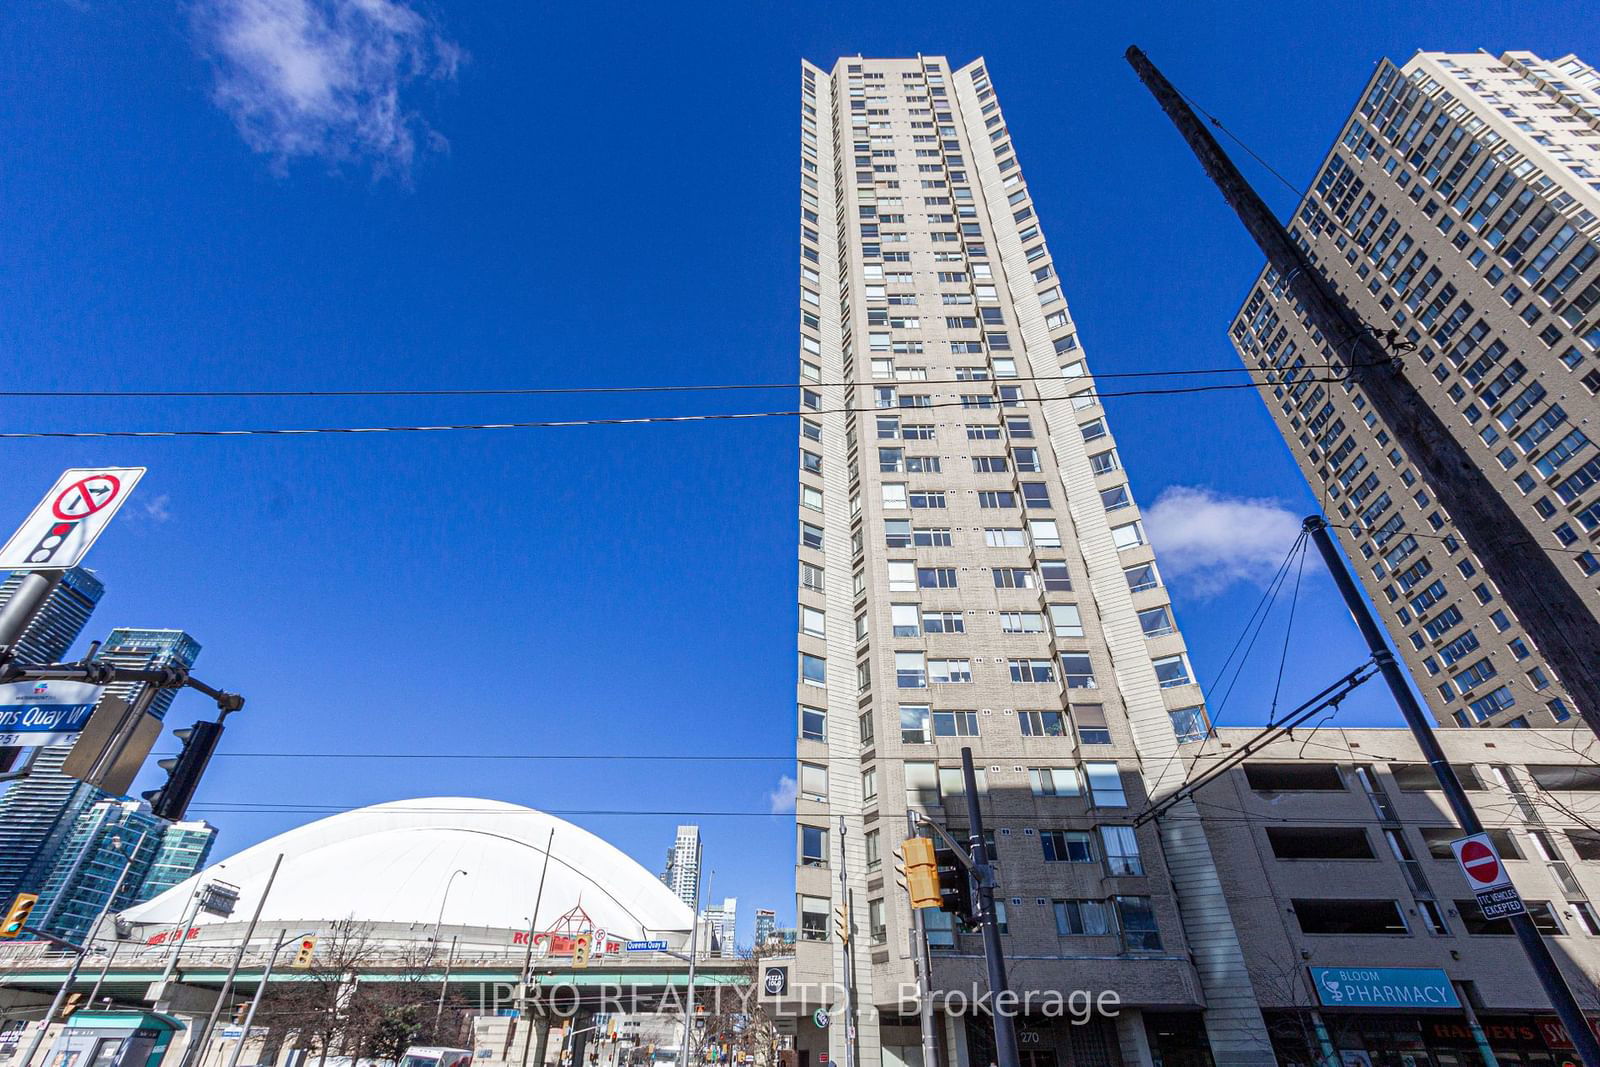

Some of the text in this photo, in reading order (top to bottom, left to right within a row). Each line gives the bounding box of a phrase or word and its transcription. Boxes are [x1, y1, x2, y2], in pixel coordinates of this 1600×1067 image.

[23, 707, 67, 729] Quay
[66, 706, 87, 724] W
[1490, 889, 1518, 902] VEHICLES
[1484, 900, 1521, 915] EXCEPTED
[628, 941, 647, 949] Queens
[647, 941, 661, 951] Quay
[1339, 971, 1380, 981] BLOOM
[1345, 985, 1448, 1003] PHARMACY
[1020, 1032, 1039, 1043] 270
[1433, 1024, 1535, 1039] HAEY'S
